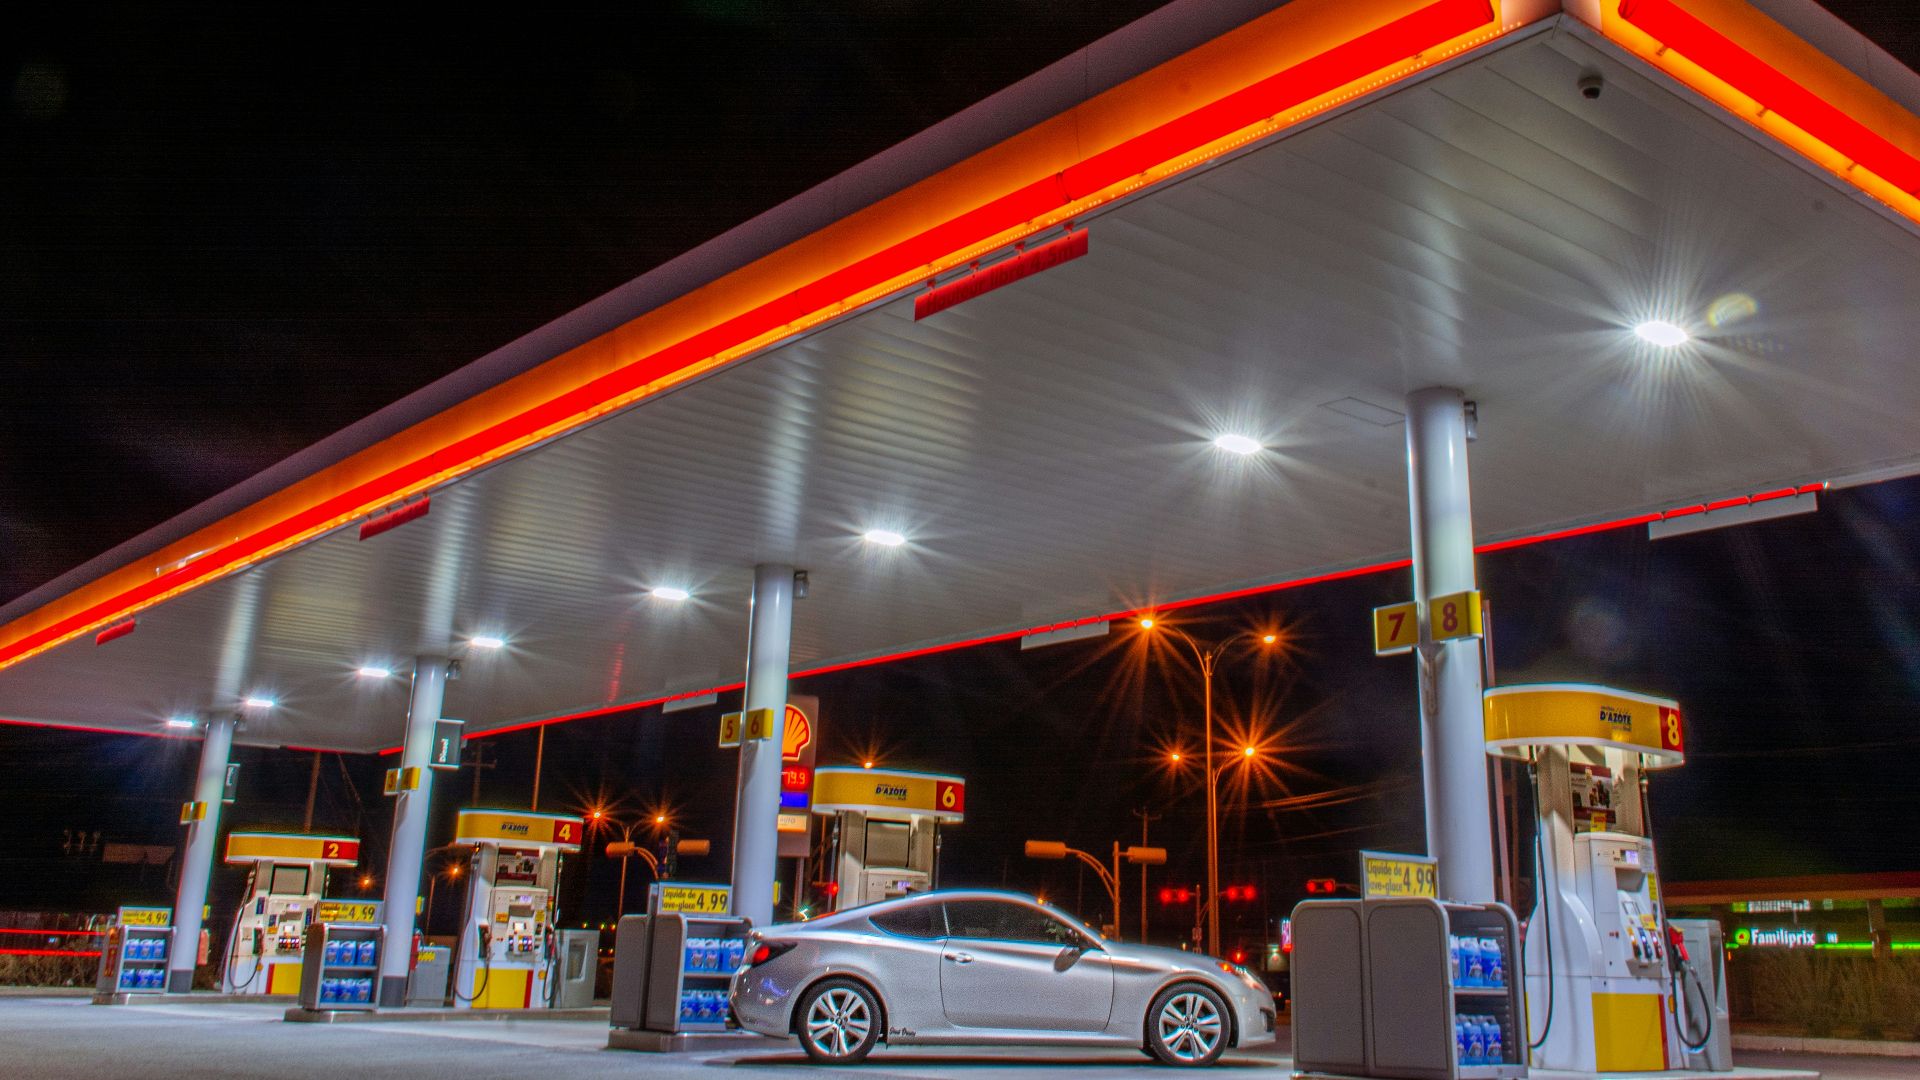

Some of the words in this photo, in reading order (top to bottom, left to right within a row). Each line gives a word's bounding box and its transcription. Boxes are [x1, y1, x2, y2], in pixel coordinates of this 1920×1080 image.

[1388, 612, 1406, 642] 7
[1442, 602, 1458, 632] 8
[750, 715, 760, 735] 6
[1599, 710, 1632, 726] D'AZOTE
[724, 719, 734, 739] 5
[1667, 713, 1680, 746] 8
[942, 785, 956, 808] 6
[558, 823, 571, 841] 4
[328, 843, 339, 858] 2
[1750, 927, 1817, 948] Familiprix
